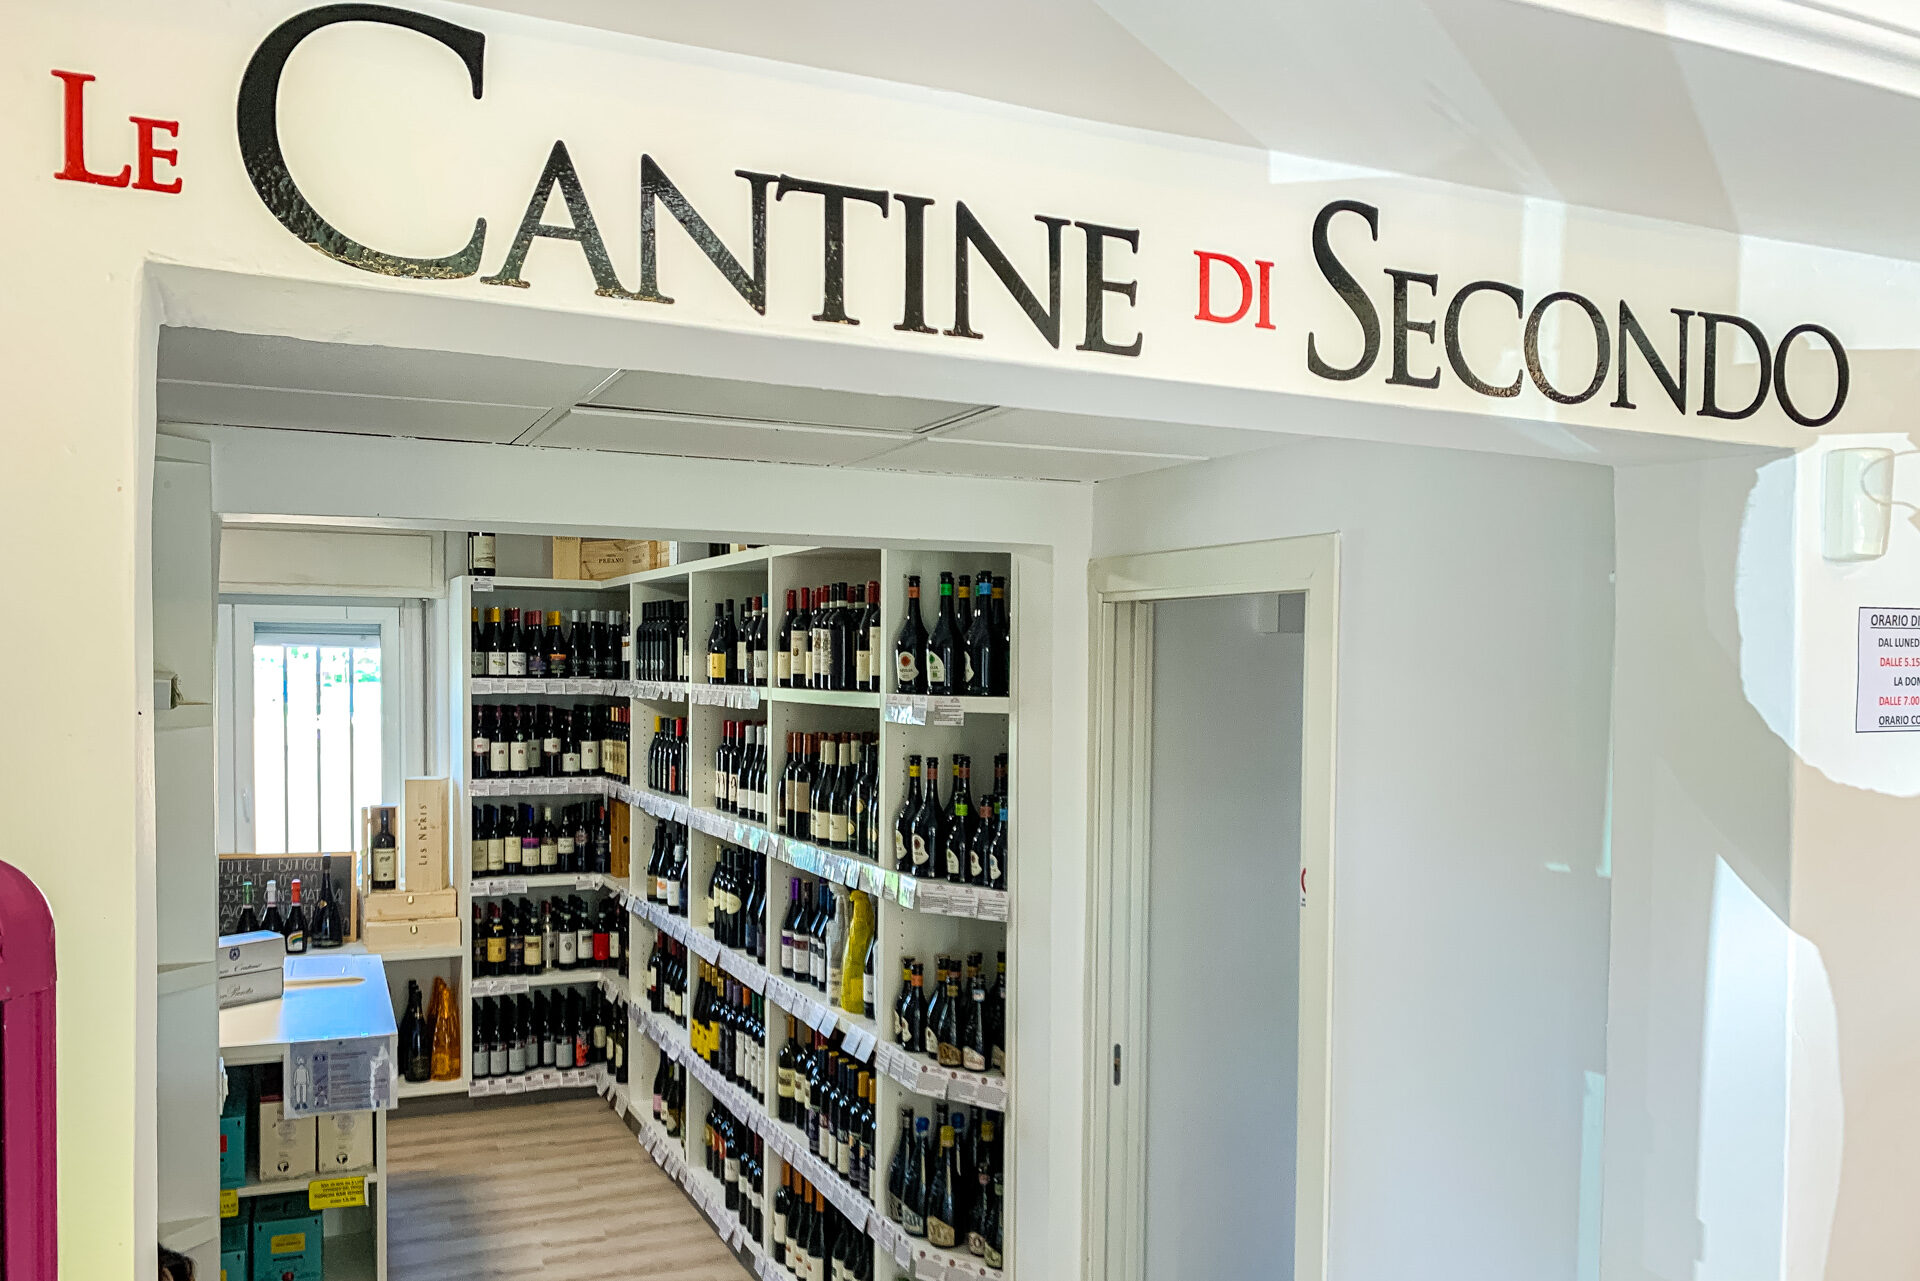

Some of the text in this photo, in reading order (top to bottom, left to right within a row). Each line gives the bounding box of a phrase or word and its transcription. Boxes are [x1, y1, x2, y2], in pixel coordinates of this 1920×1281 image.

[236, 3, 1144, 358] CANTINE
[1193, 249, 1275, 330] DI
[1307, 199, 1850, 428] SECONDO
[1870, 614, 1909, 627] ORARIO
[1878, 637, 1893, 648] DAL
[1880, 657, 1920, 667] DALLE 5.15
[1893, 677, 1903, 686] LA
[1879, 696, 1920, 706] DALLE 7.00
[1878, 715, 1909, 726] ORARIO
[417, 804, 428, 866] LIS NERIS
